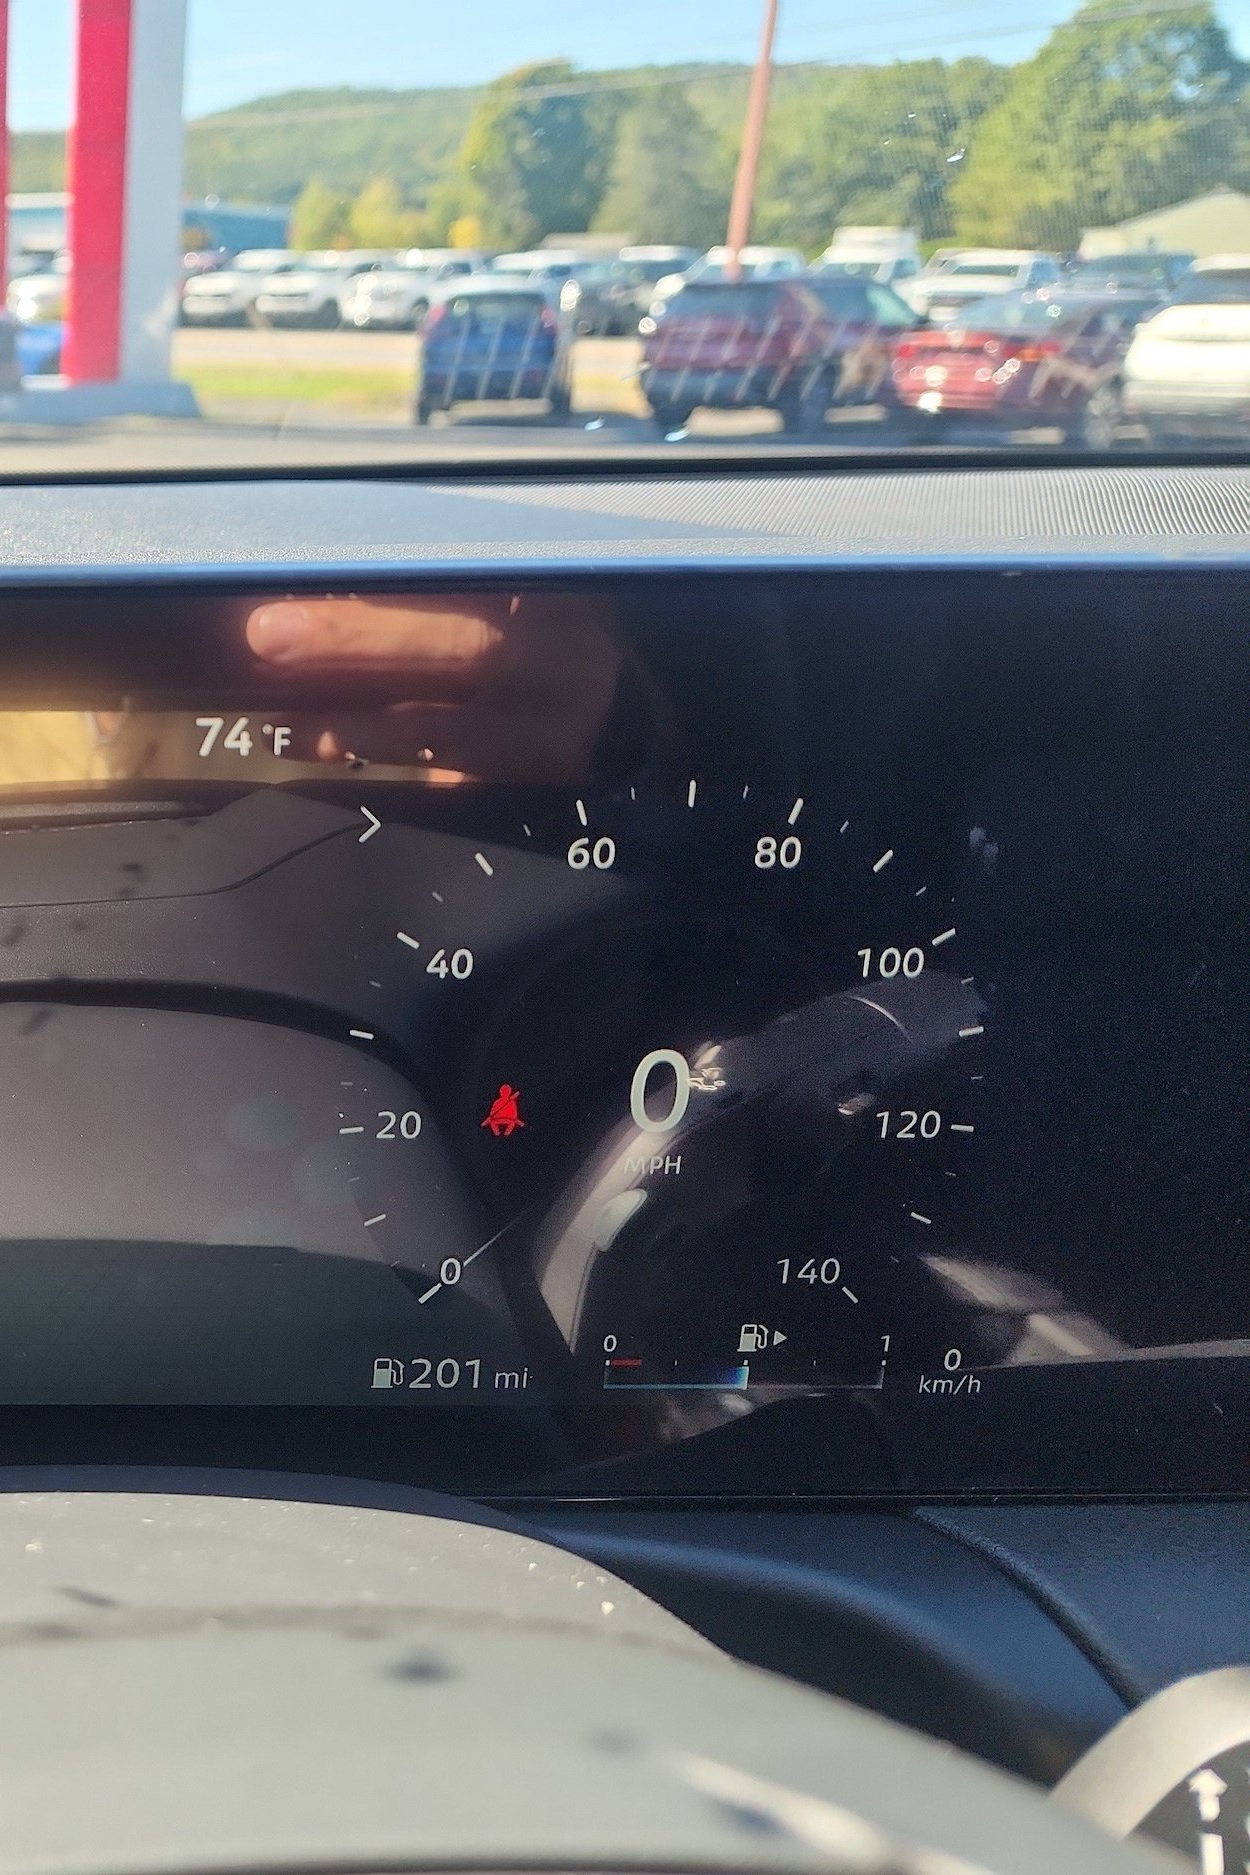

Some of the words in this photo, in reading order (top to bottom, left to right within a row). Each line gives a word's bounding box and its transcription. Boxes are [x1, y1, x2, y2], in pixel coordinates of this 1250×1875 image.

[567, 836, 617, 870] 60
[754, 836, 802, 870] 80
[425, 948, 474, 980] 40
[856, 946, 926, 979] 100
[630, 1048, 691, 1134] 0
[375, 1110, 424, 1142] 20
[875, 1110, 942, 1140] 120
[623, 1154, 683, 1177] MPH
[439, 1258, 462, 1287] 0
[776, 1258, 842, 1286] 140
[603, 1334, 618, 1353] 0
[880, 1334, 892, 1352] 1
[408, 1358, 481, 1389] 201
[494, 1367, 529, 1389] mi
[944, 1348, 963, 1371] 0
[918, 1375, 982, 1396] km/h
